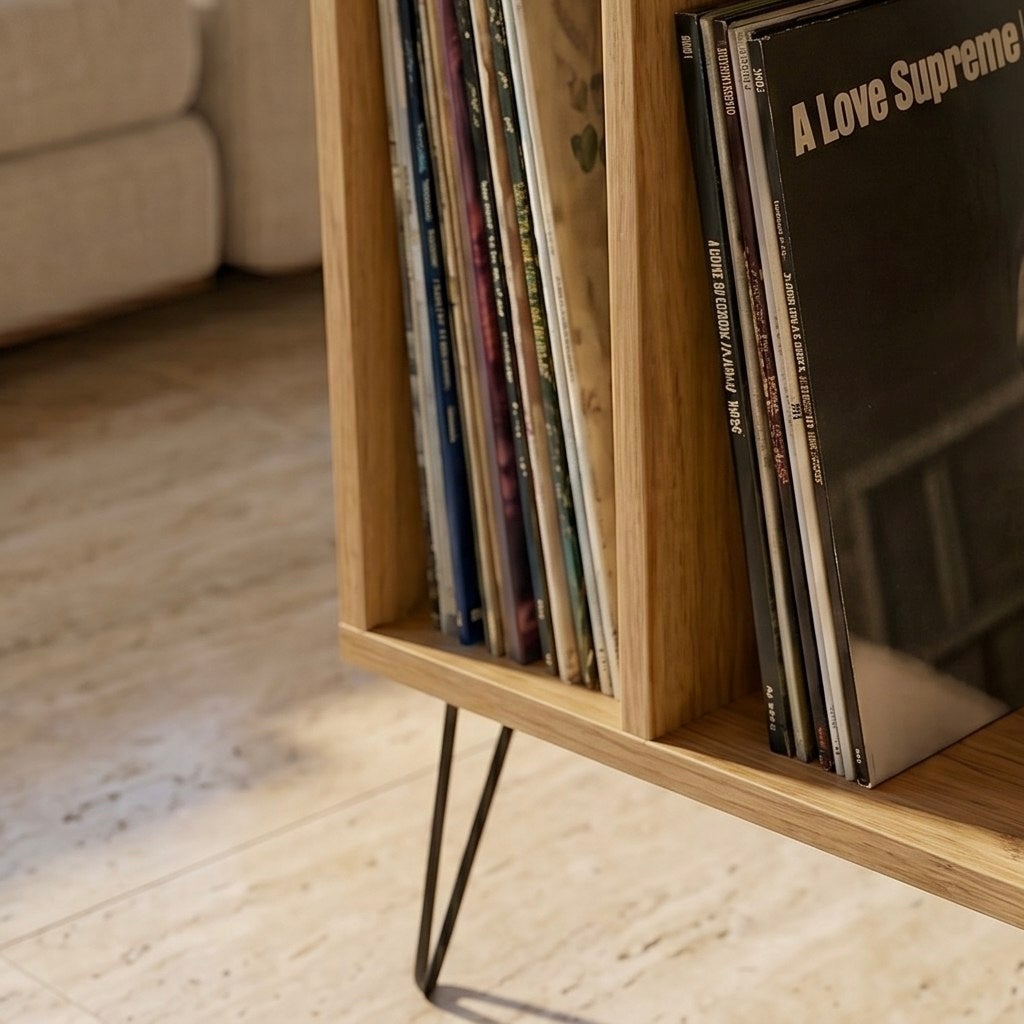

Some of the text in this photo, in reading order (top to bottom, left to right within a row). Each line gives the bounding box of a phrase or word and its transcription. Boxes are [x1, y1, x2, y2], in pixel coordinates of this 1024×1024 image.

[791, 101, 817, 157] A
[816, 78, 889, 145] Love
[890, 22, 1021, 111] Supreme
